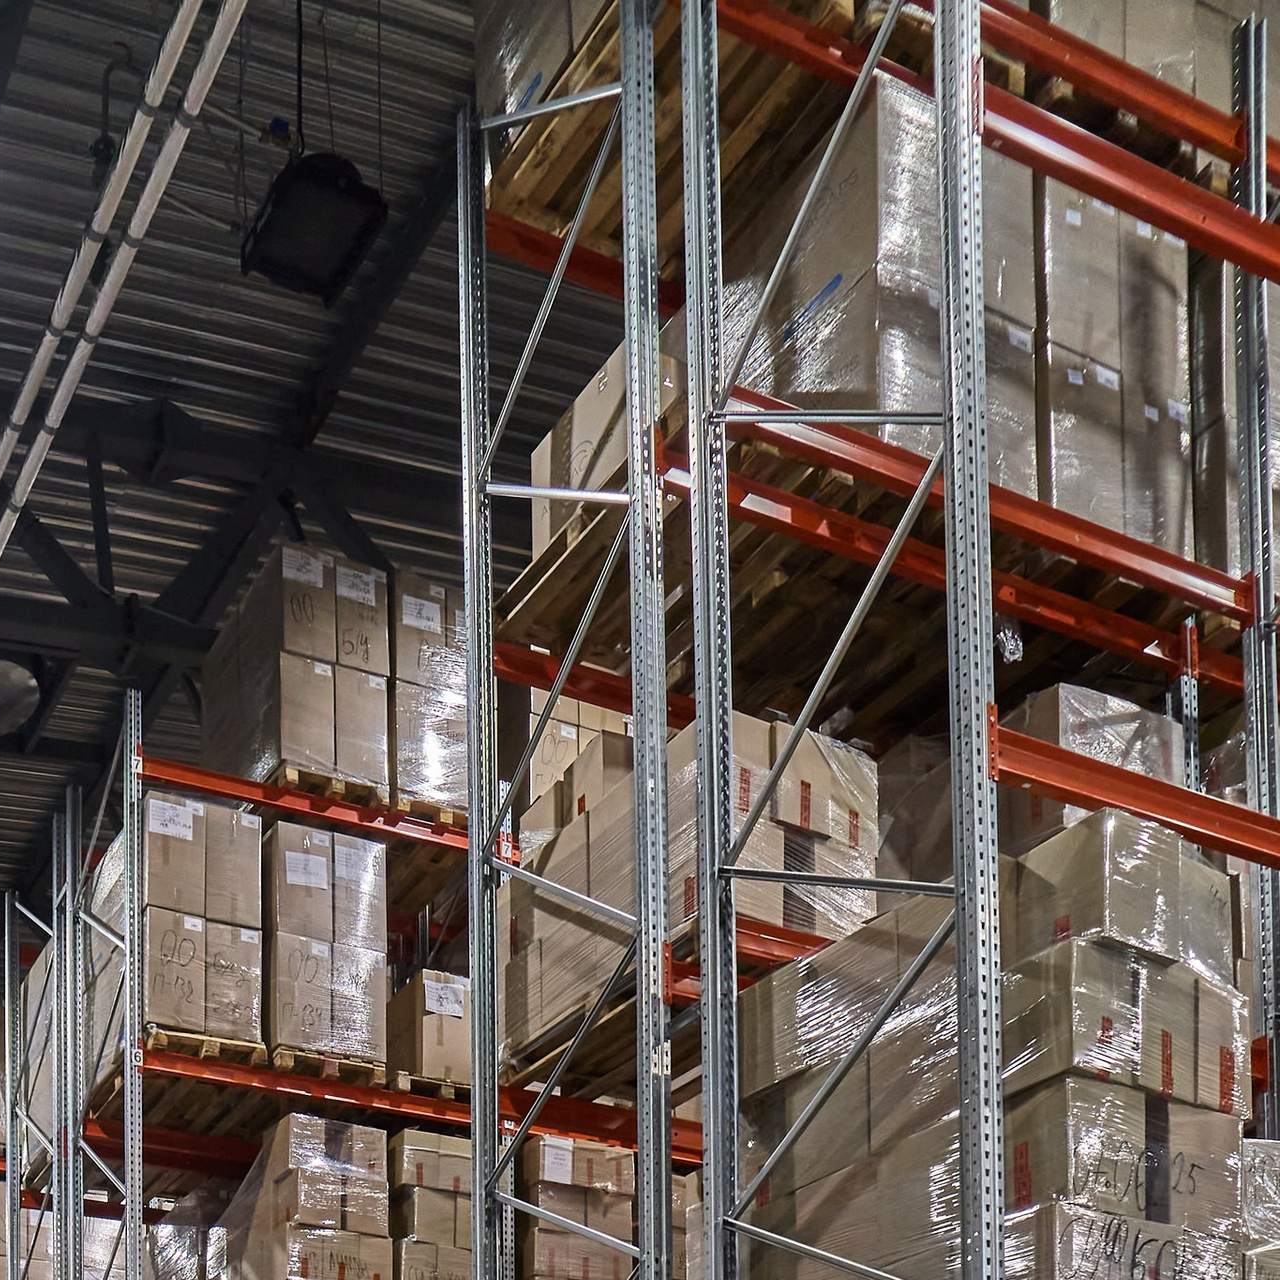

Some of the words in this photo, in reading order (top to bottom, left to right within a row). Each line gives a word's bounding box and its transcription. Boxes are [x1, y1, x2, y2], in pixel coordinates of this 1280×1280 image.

[133, 758, 140, 770] 7
[504, 843, 510, 855] 7
[134, 1051, 142, 1063] 6
